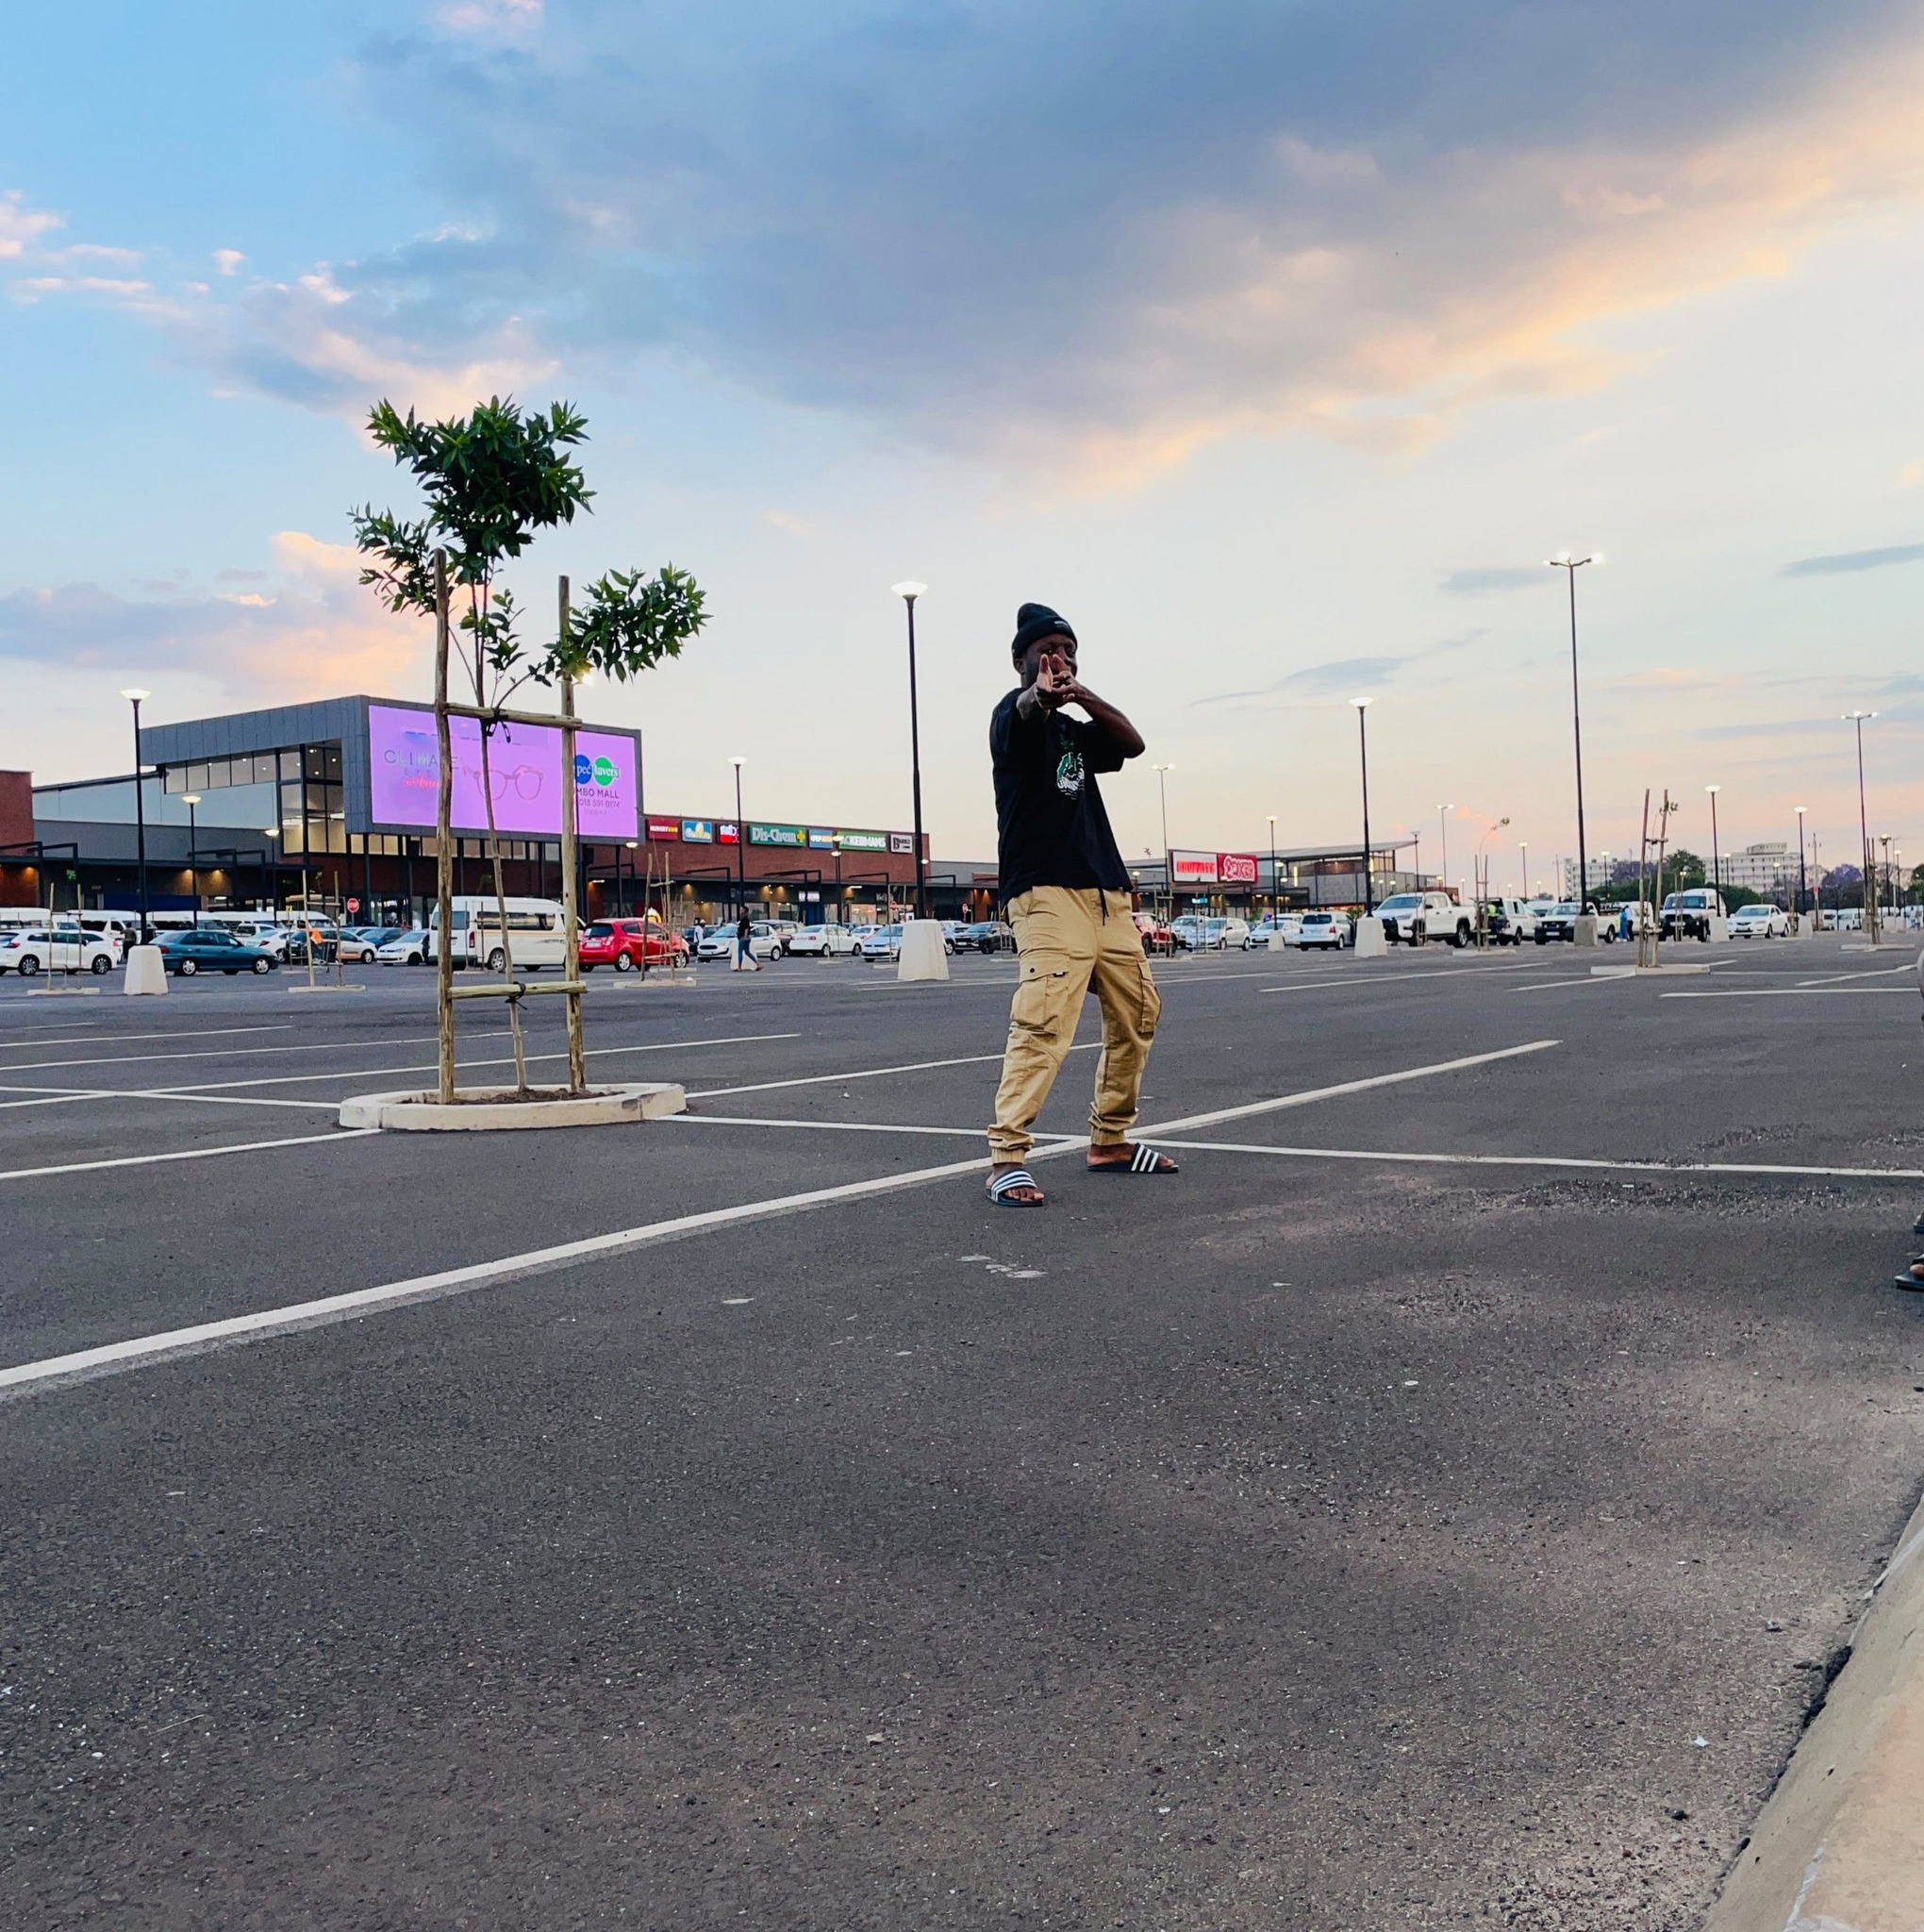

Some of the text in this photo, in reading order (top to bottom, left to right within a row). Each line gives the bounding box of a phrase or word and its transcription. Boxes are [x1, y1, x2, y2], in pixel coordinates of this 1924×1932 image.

[384, 749, 459, 770] CLIMAE
[575, 787, 620, 799] MBO MALL
[752, 827, 796, 842] Dis-Chem
